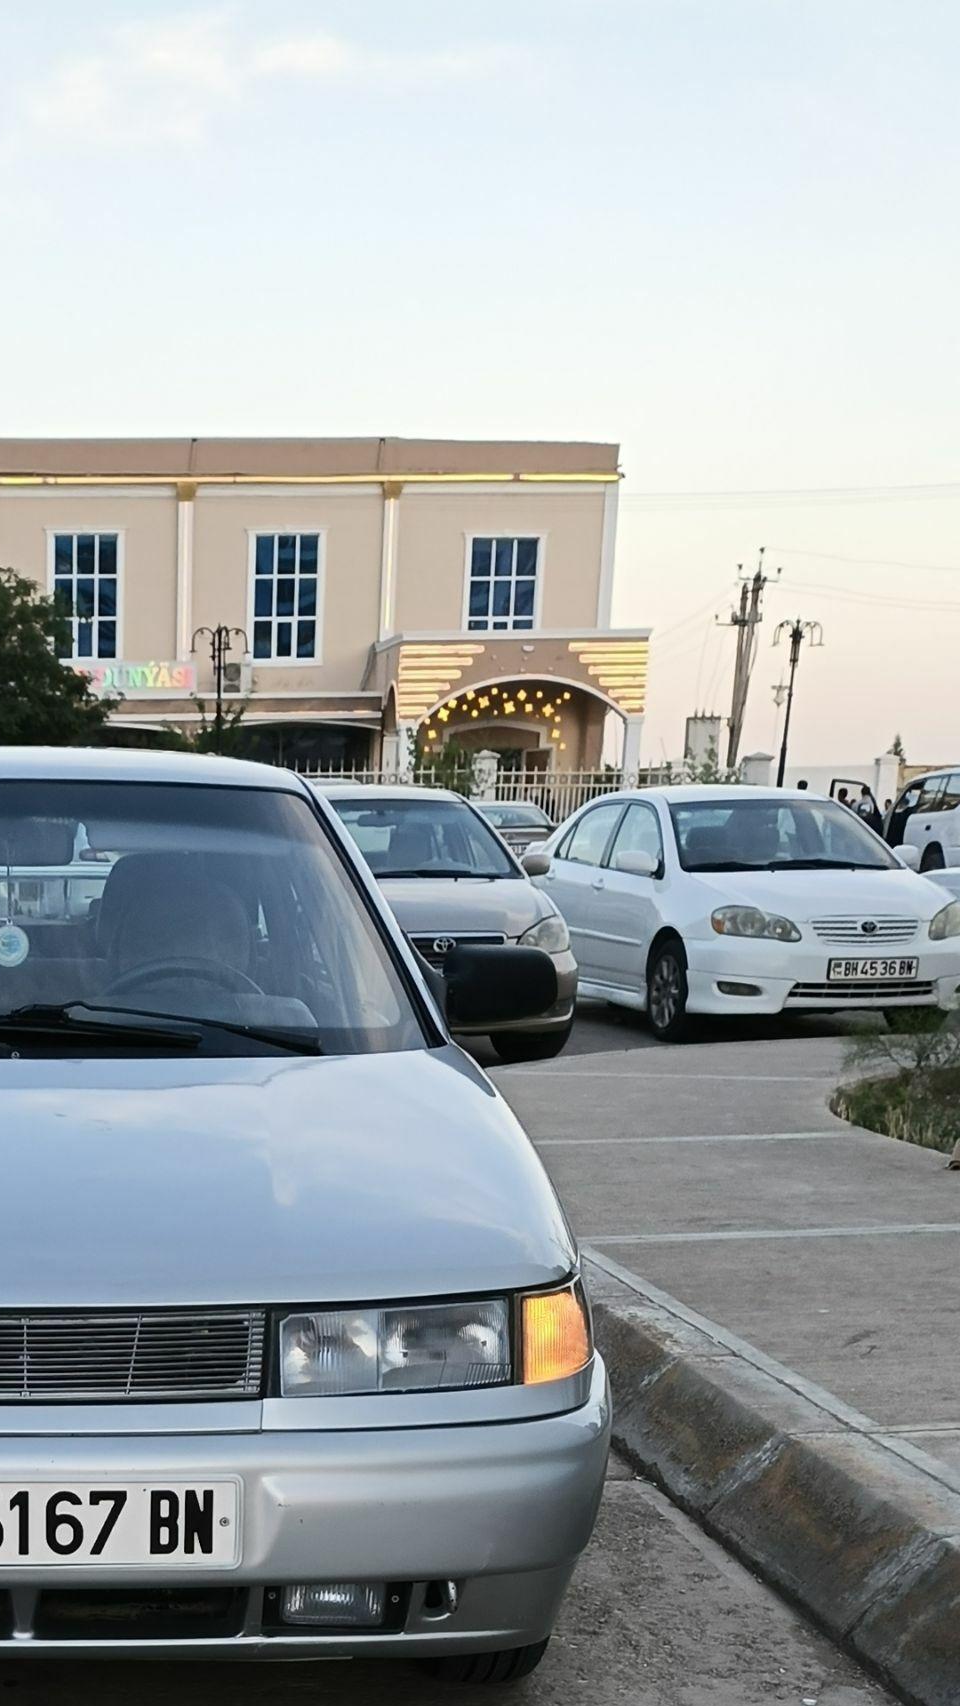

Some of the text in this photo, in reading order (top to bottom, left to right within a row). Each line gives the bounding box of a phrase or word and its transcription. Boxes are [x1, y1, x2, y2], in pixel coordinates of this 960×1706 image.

[860, 960, 897, 977] 4536
[898, 960, 914, 976] BN
[149, 1489, 214, 1555] BN
